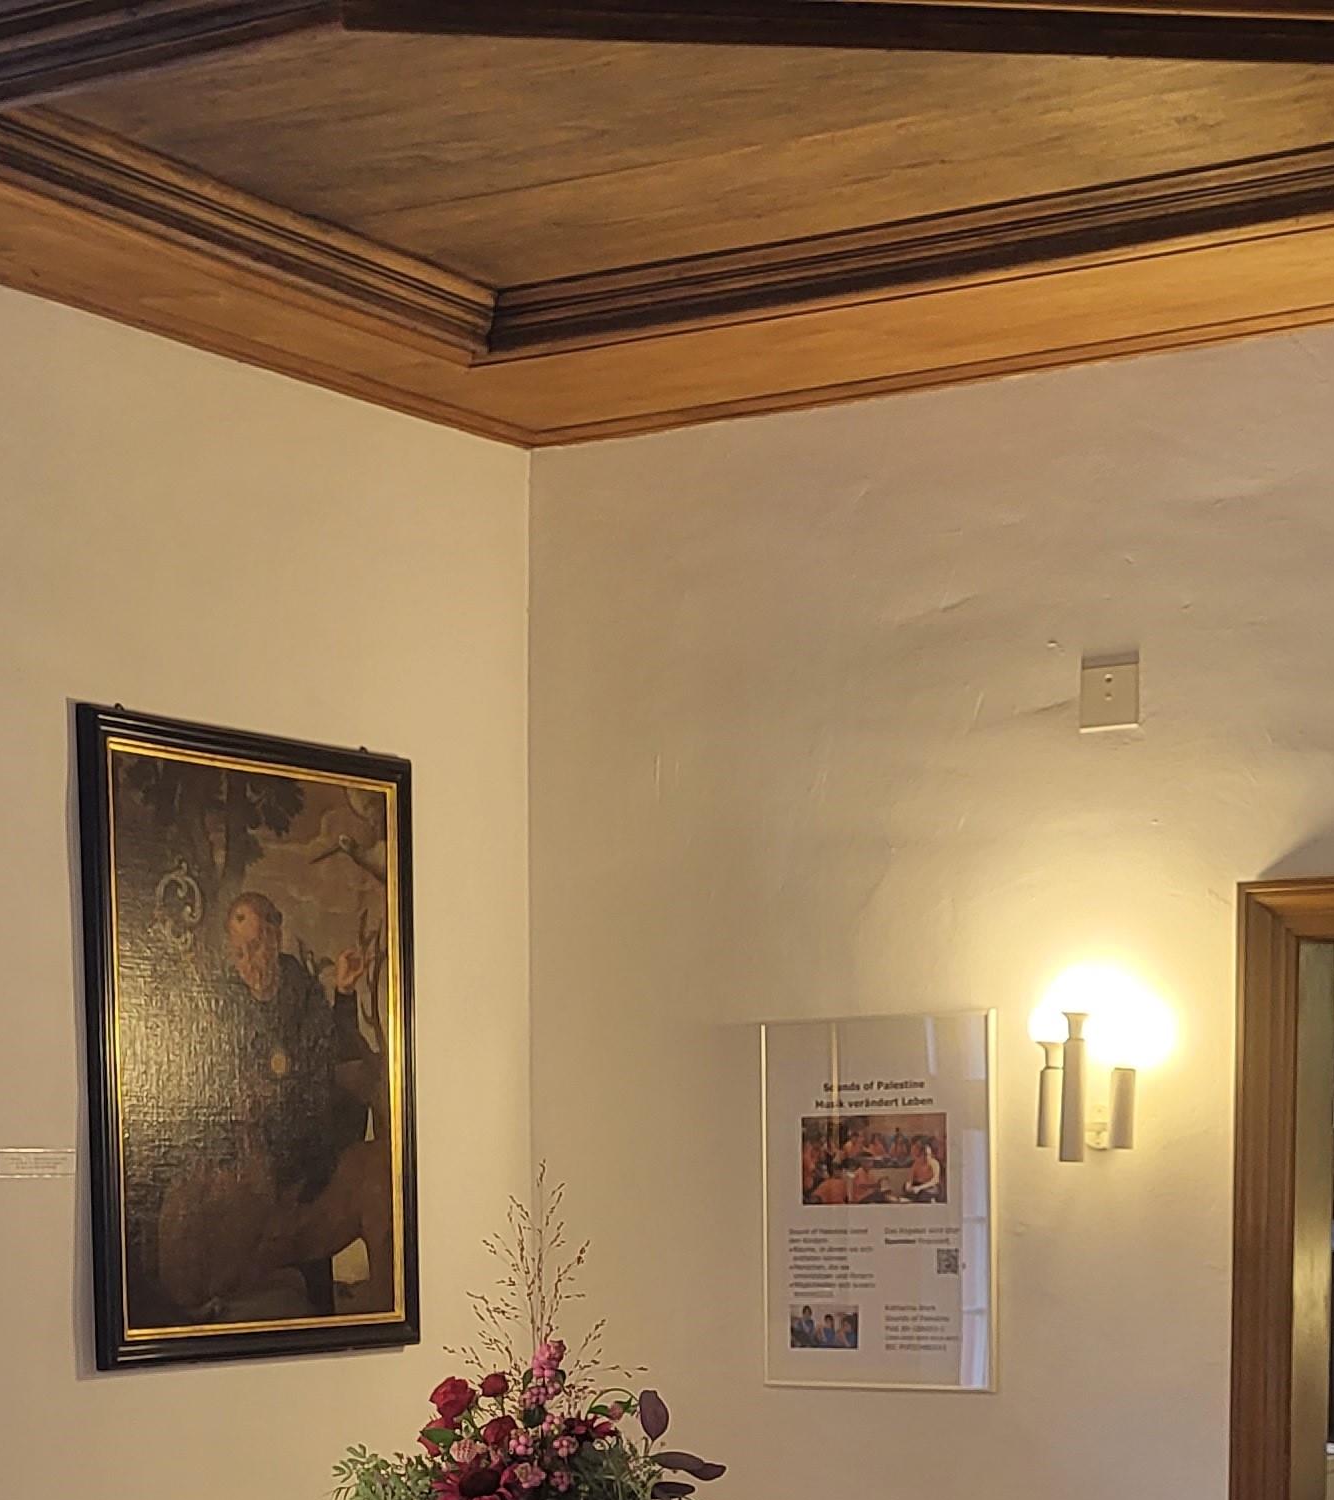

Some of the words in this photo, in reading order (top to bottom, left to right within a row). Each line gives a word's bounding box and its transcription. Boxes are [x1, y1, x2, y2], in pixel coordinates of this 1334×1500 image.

[863, 1081, 874, 1091] of
[876, 1080, 925, 1090] Palestine
[815, 1100, 844, 1109] Musk
[901, 1097, 934, 1106] Leben
